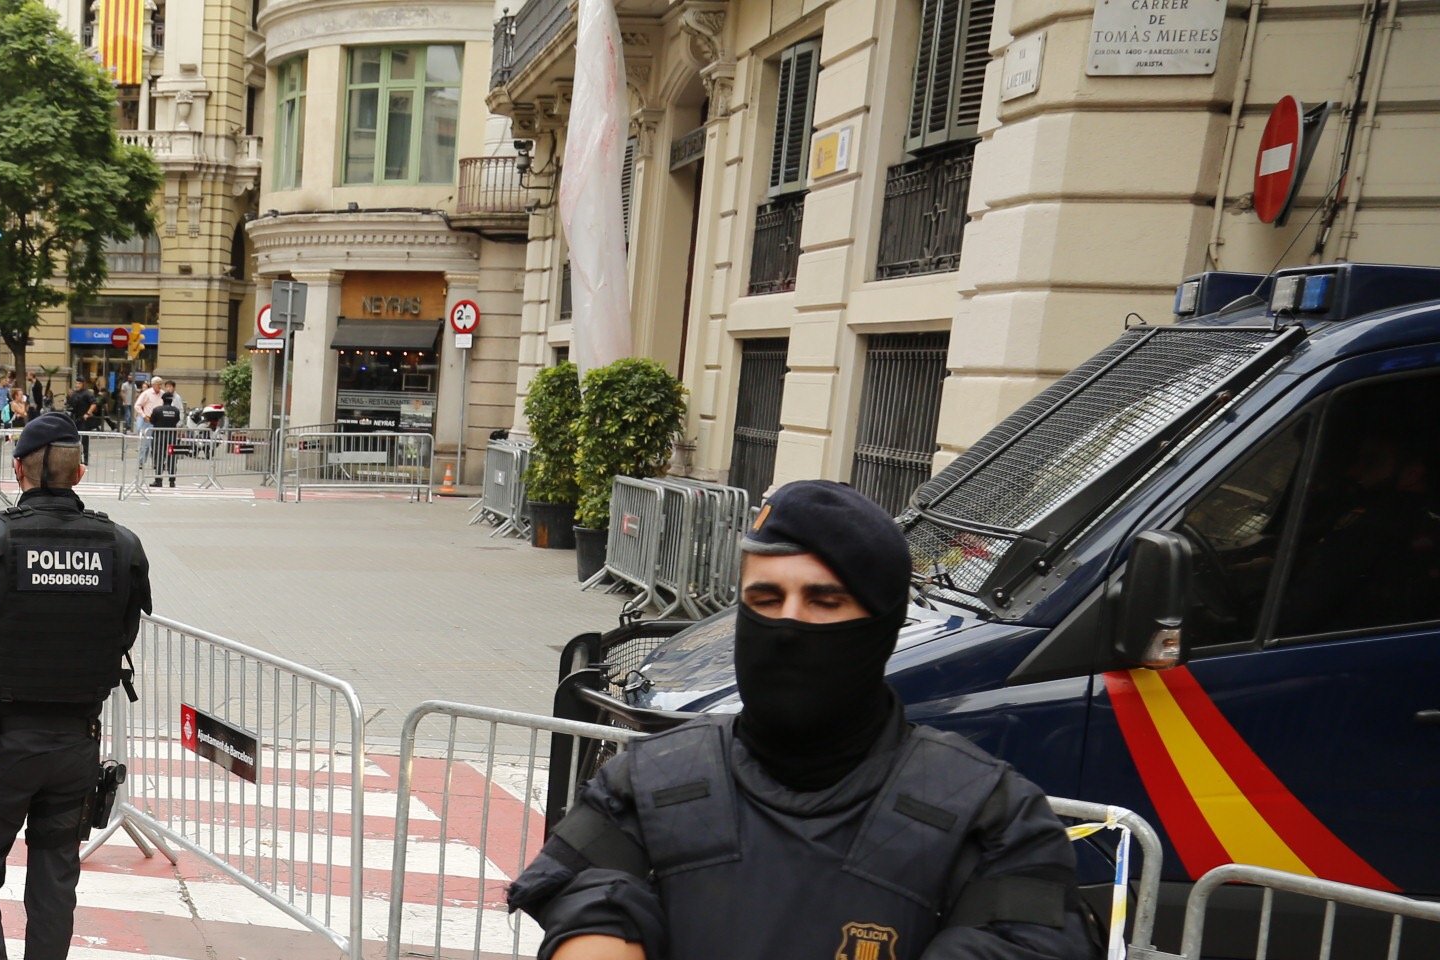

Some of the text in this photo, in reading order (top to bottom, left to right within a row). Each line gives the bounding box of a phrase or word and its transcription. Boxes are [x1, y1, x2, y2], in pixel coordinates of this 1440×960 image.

[1132, 0, 1189, 10] CARRER
[1149, 15, 1166, 25] DE
[1094, 25, 1219, 43] TOMÀS MIERES
[362, 296, 421, 315] NEYRAS
[456, 309, 464, 321] 2
[27, 550, 103, 571] POLICIA
[849, 927, 889, 941] POLICIA
